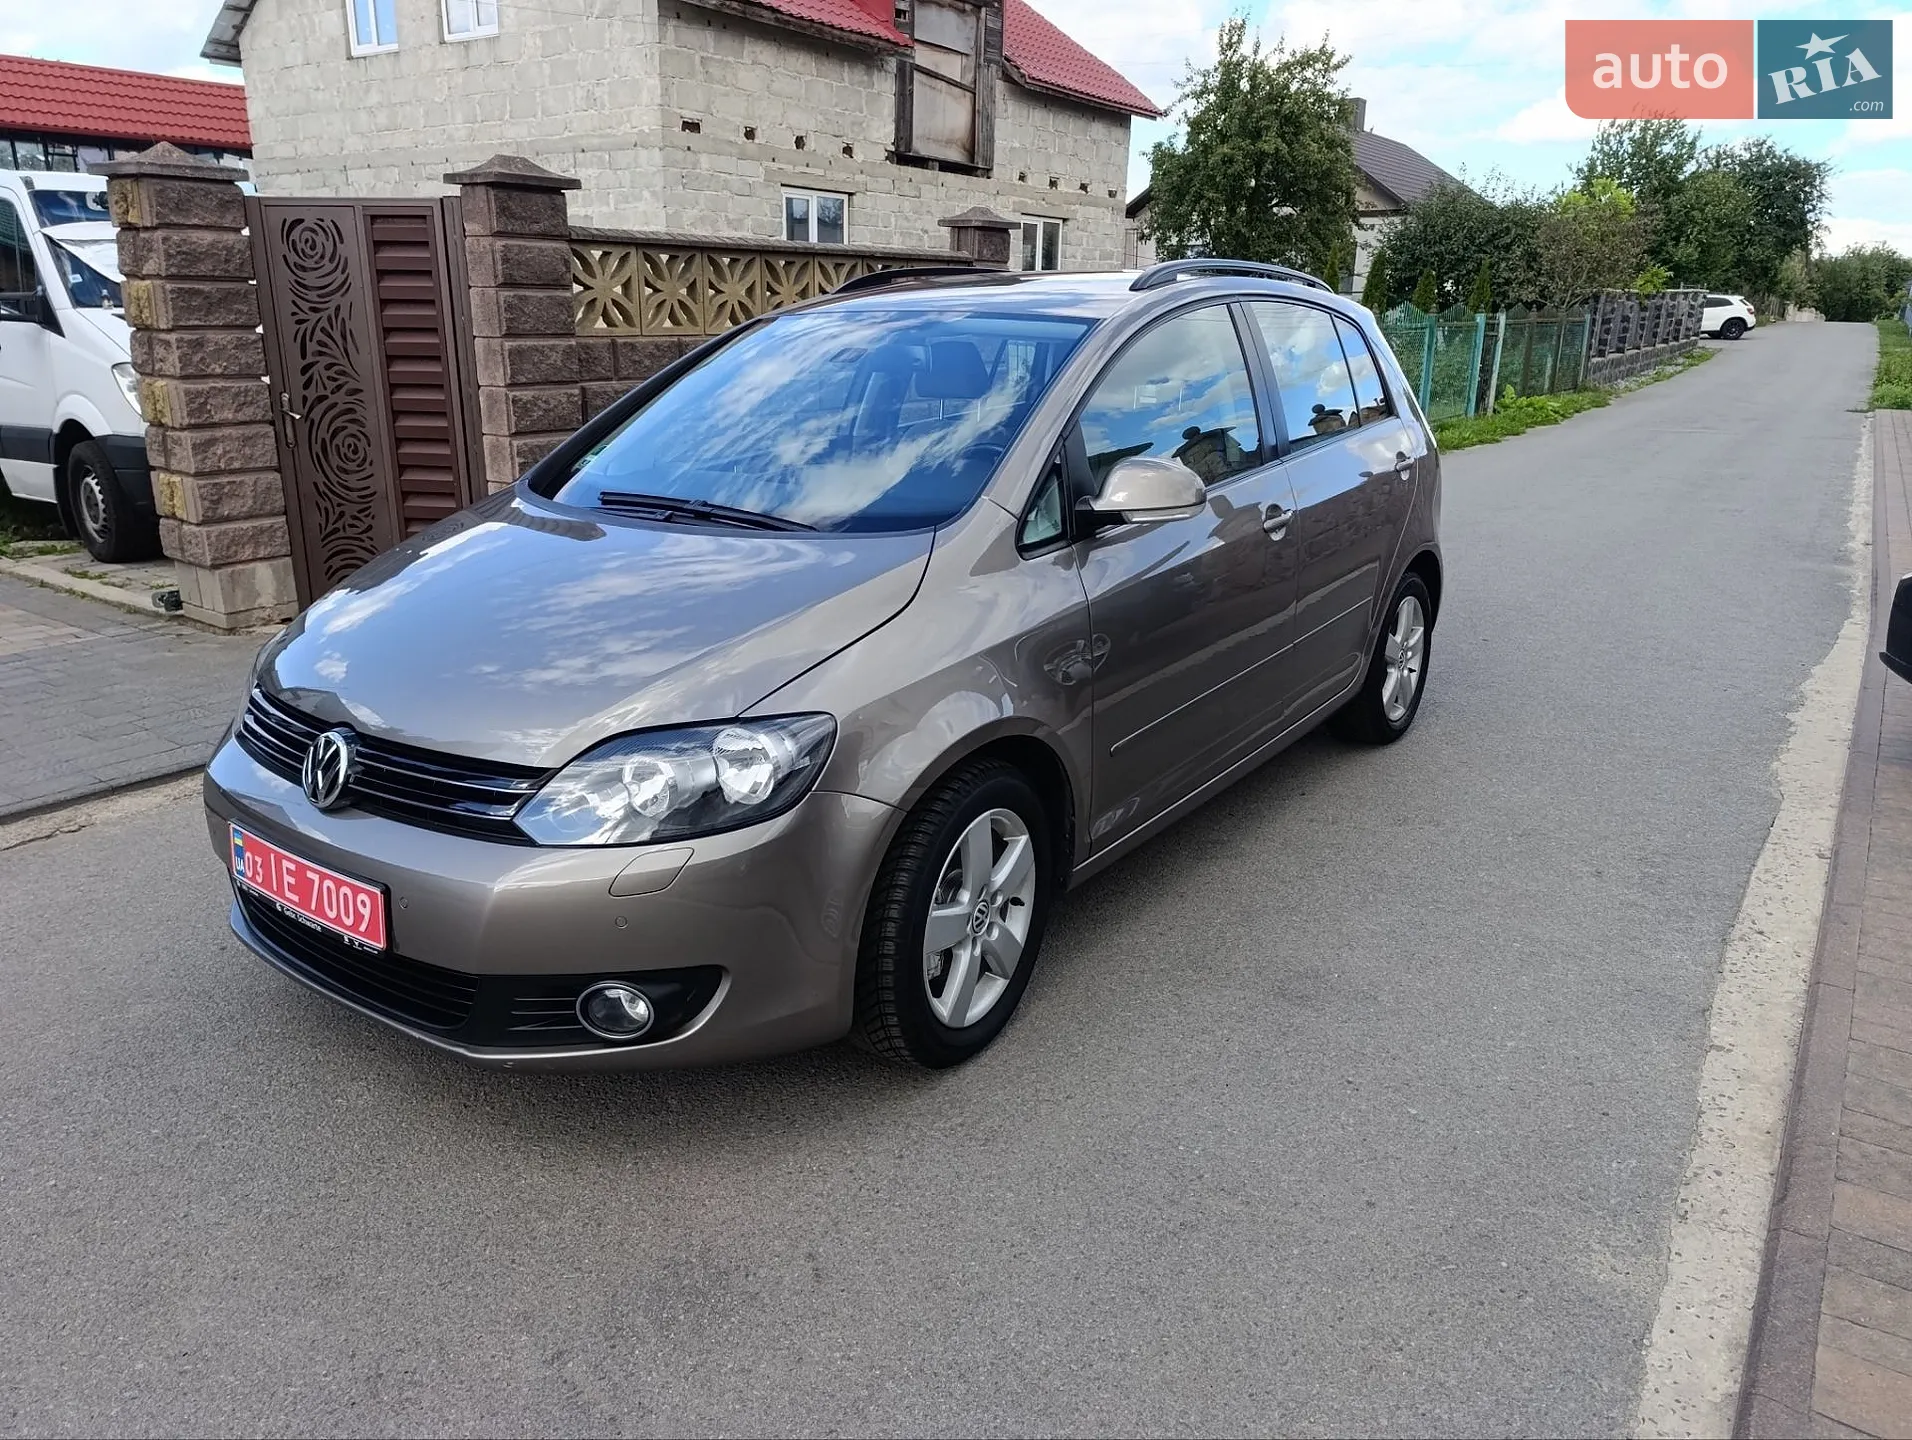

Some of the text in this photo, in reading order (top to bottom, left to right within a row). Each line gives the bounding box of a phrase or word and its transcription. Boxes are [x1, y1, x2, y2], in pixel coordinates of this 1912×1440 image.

[235, 856, 244, 873] UA
[244, 851, 372, 933] 03 IE 7009
